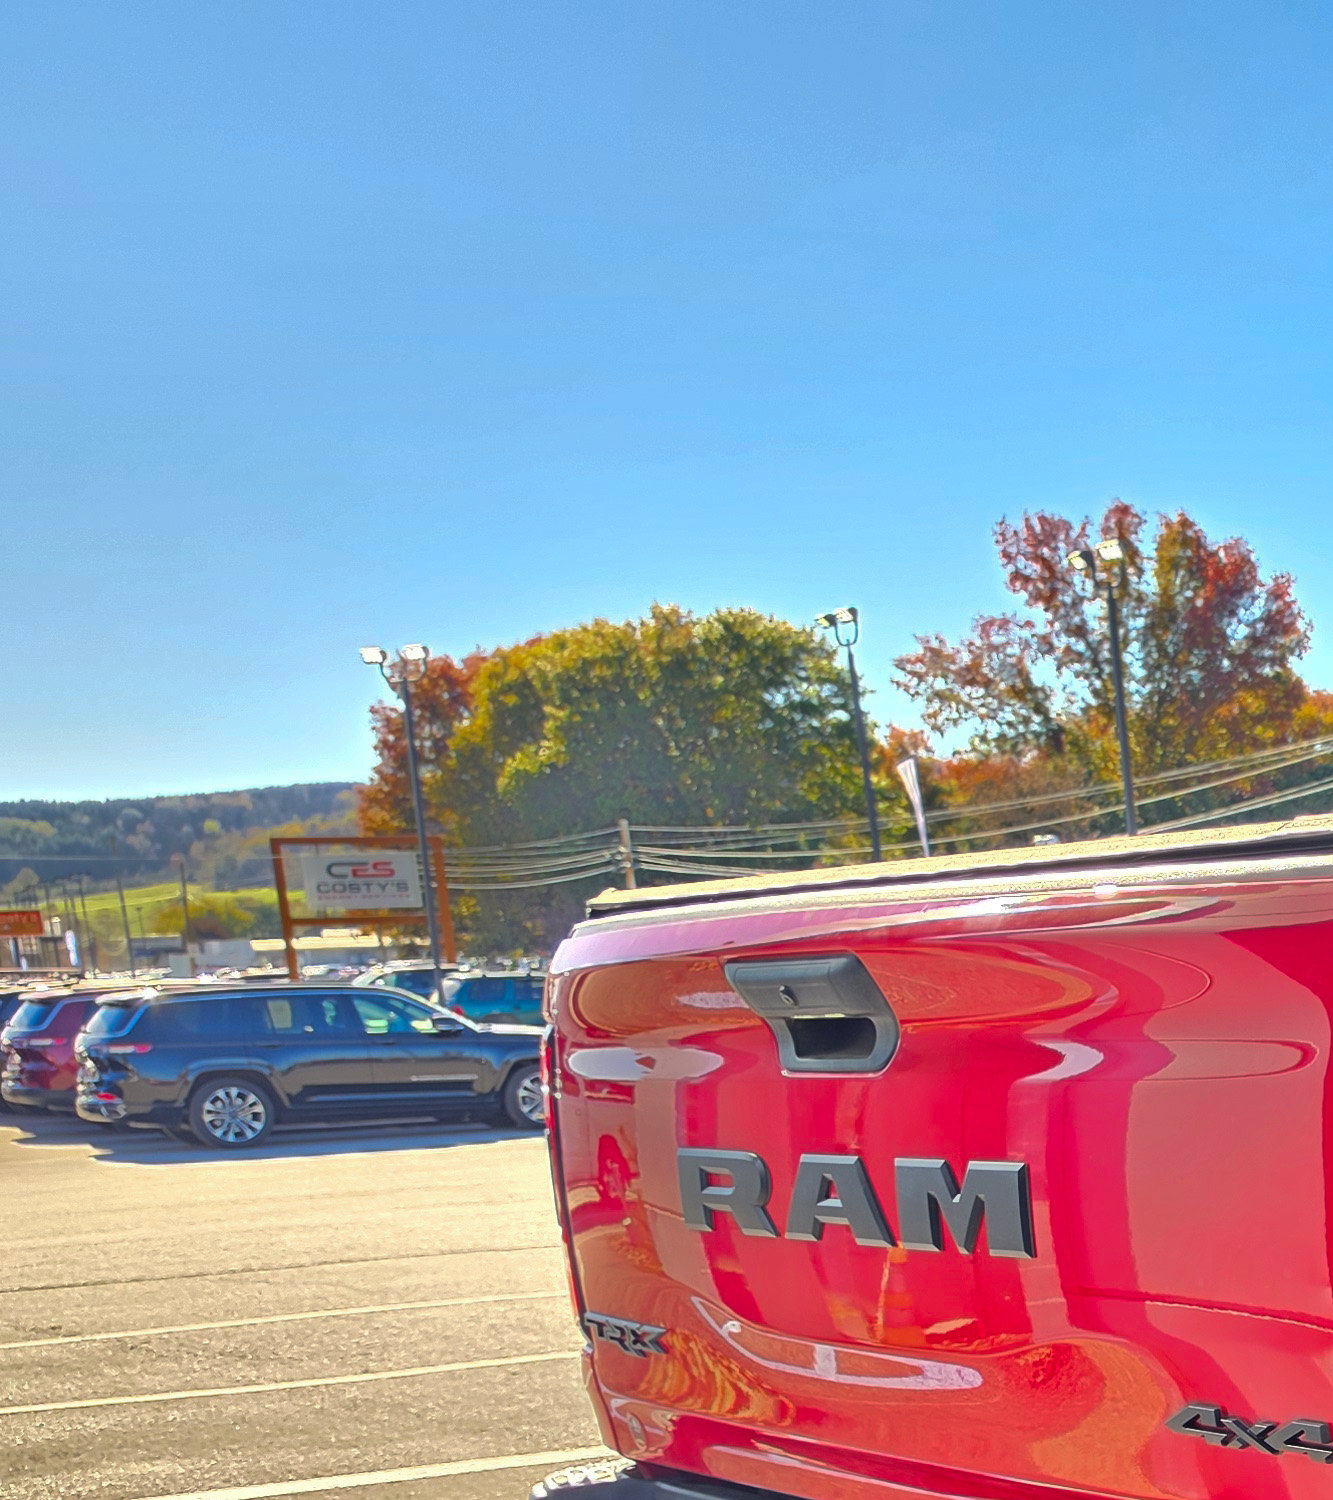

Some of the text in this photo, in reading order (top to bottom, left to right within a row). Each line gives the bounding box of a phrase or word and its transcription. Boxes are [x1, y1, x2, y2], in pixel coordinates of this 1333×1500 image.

[326, 861, 396, 879] CES
[316, 881, 410, 893] COSTY'S
[677, 1147, 1038, 1259] RAM
[583, 1310, 669, 1358] TRX
